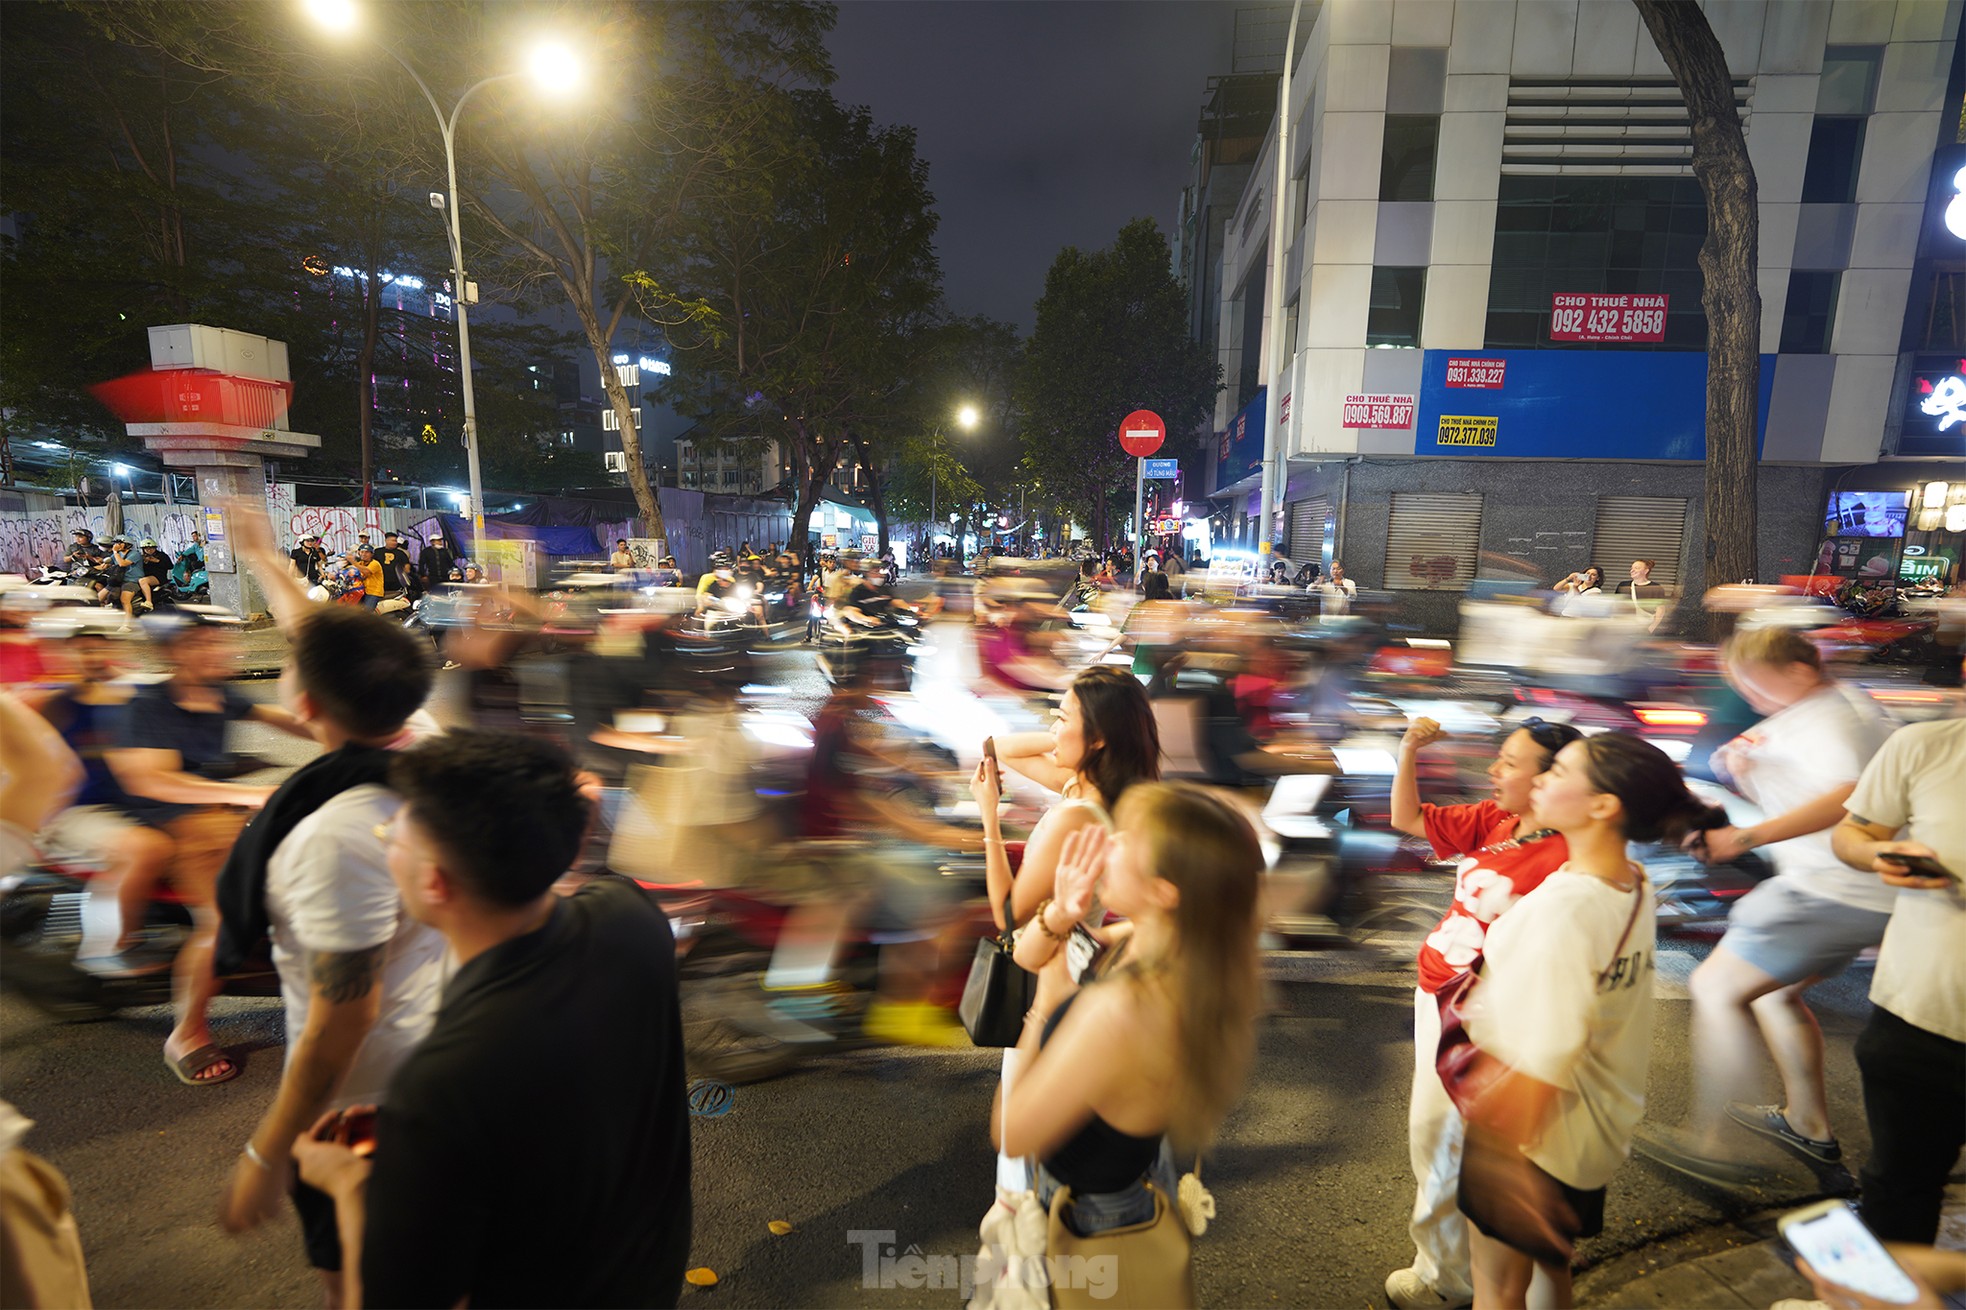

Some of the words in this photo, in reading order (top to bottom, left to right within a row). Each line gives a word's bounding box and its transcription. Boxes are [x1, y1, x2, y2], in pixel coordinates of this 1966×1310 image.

[1554, 296, 1586, 306] CHO
[1591, 295, 1628, 307] THUÊ
[1633, 295, 1665, 307] NHÀ
[1552, 308, 1584, 333] 092
[1587, 309, 1619, 333] 432
[1622, 310, 1664, 334] 5858
[1447, 367, 1505, 383] 0931.339.227
[1346, 395, 1365, 403] CHO
[1368, 395, 1390, 403] THUÊ
[1393, 395, 1412, 403] NHÀ
[1344, 405, 1412, 424] 0909.569.887
[1439, 426, 1496, 445] 0972.377.039
[384, 552, 395, 564] P
